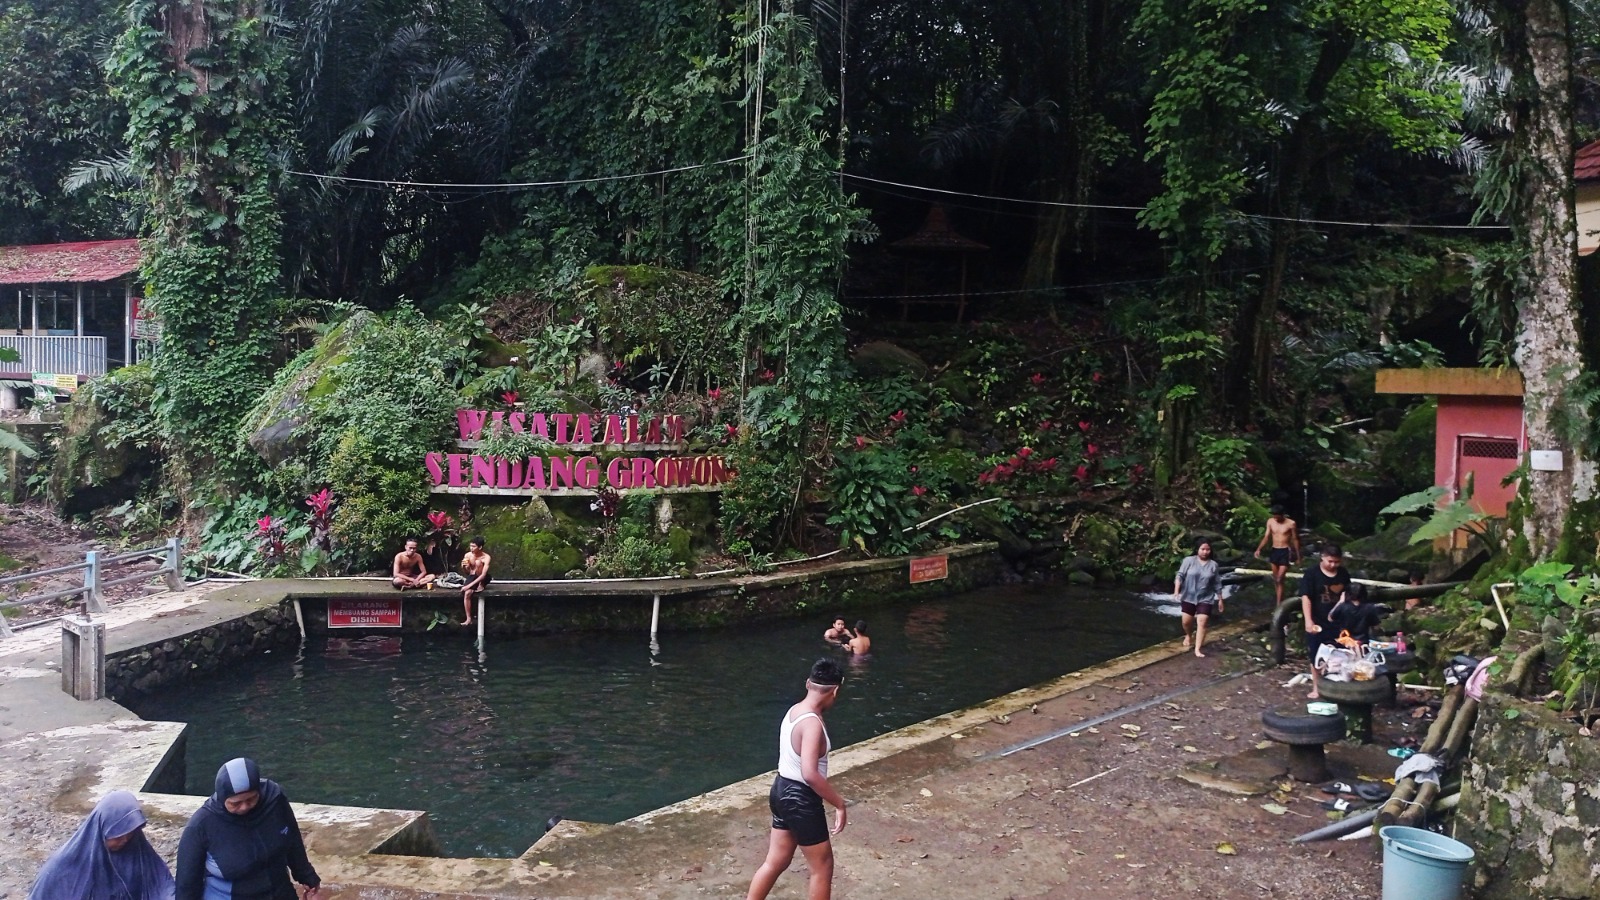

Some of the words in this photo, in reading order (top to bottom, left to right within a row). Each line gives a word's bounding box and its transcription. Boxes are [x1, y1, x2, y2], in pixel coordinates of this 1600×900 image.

[457, 410, 593, 444] WISATA
[603, 414, 683, 444] ALAM
[425, 452, 600, 489] SENDANG
[607, 455, 727, 489] GROWON
